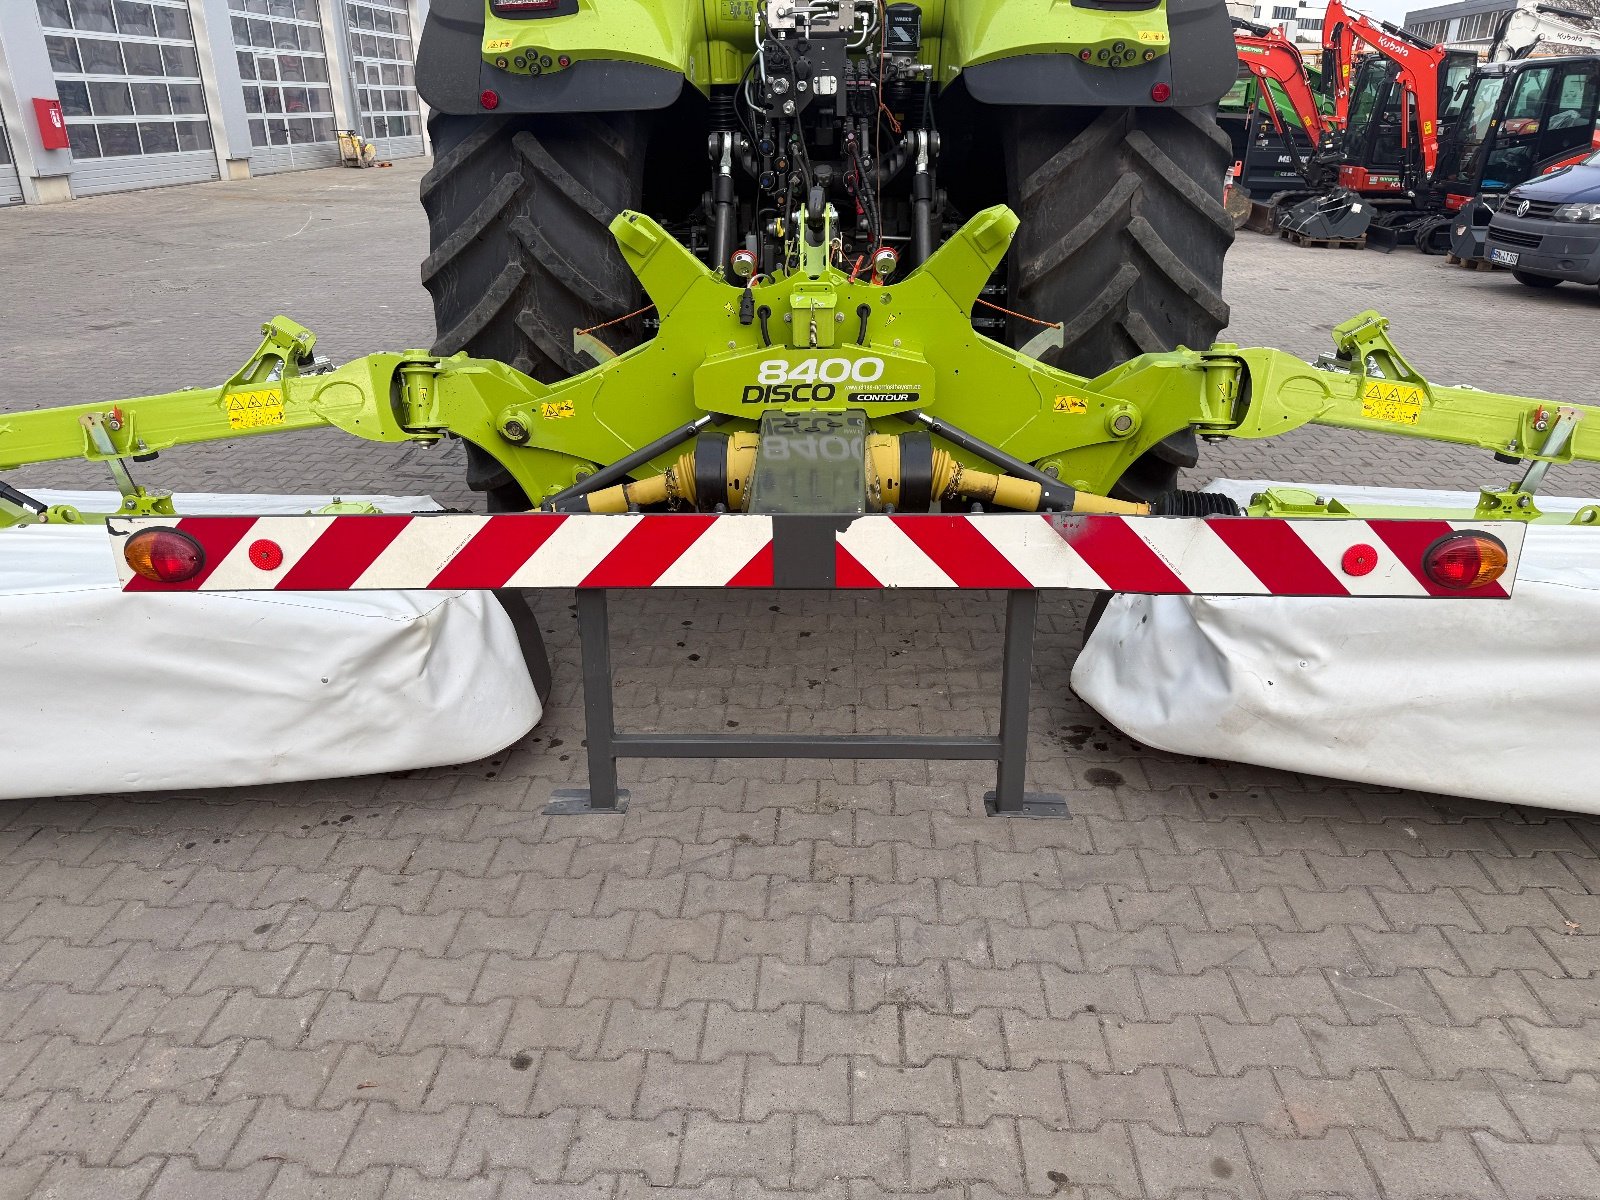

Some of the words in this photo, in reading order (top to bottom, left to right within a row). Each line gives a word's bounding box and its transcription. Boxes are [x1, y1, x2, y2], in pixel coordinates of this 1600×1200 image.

[1378, 35, 1409, 57] Kubota
[1557, 32, 1583, 42] Kubota
[757, 356, 885, 385] 8400
[741, 383, 836, 404] DISCO
[857, 393, 909, 401] CONTOUR
